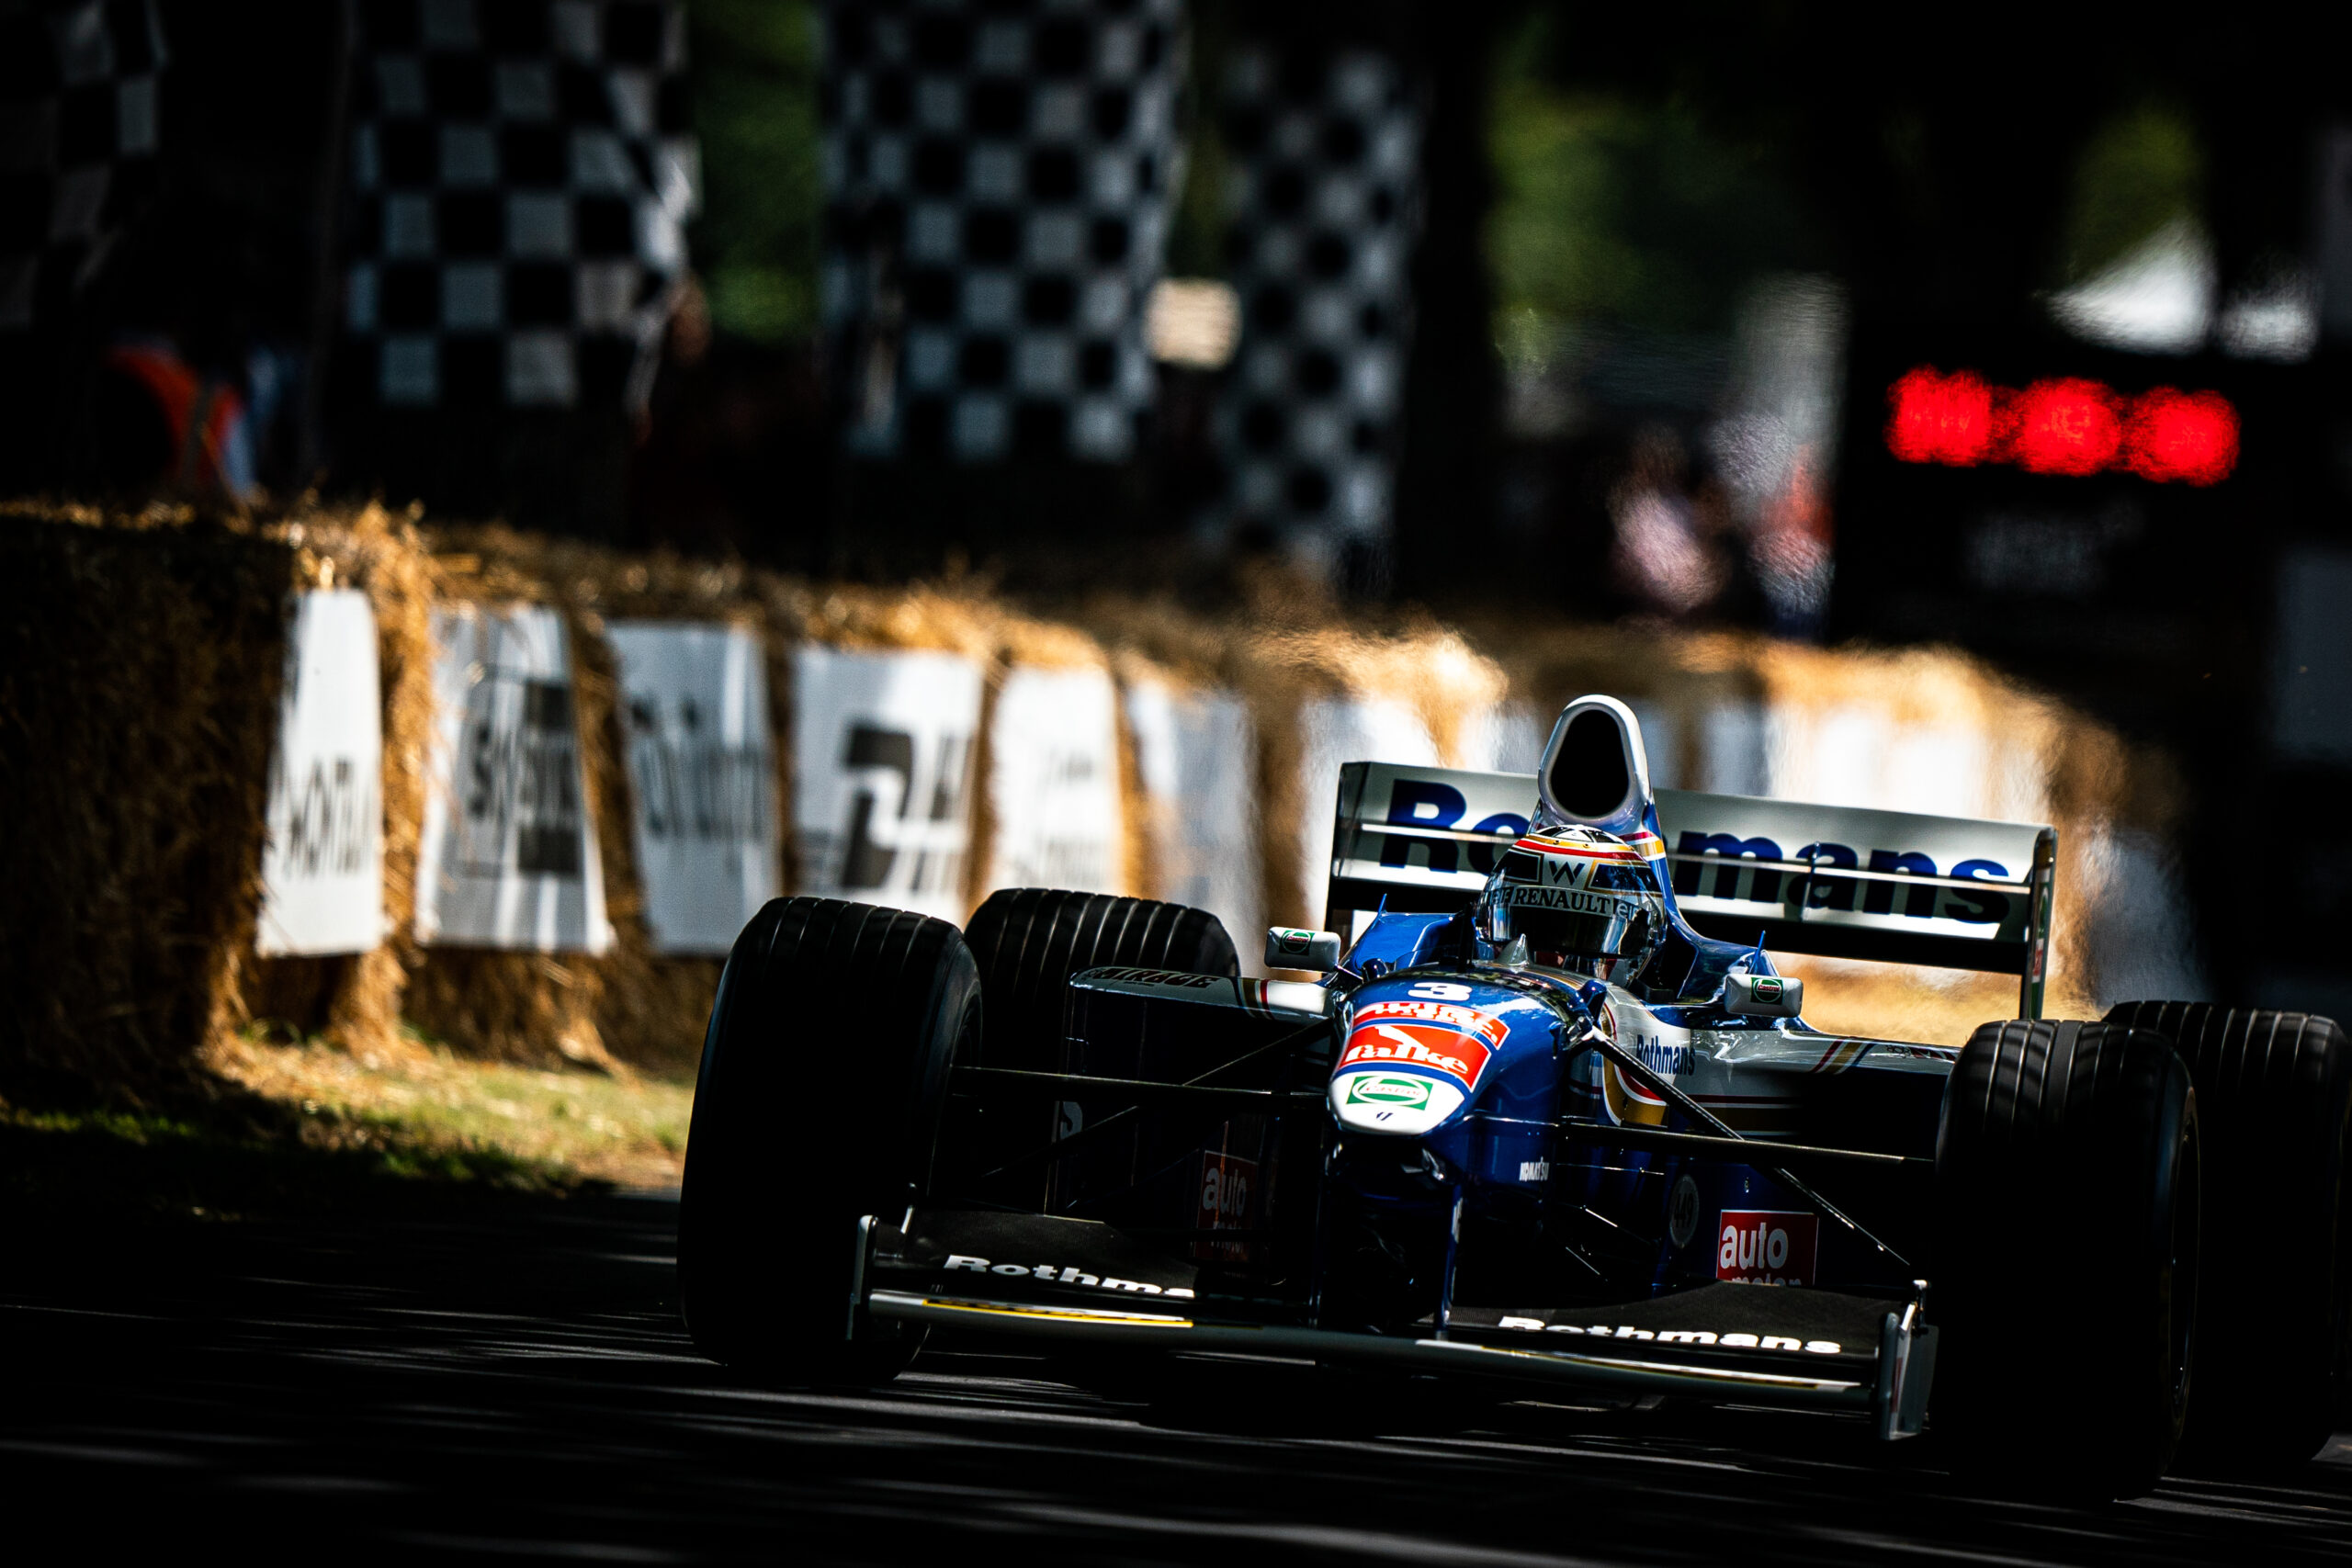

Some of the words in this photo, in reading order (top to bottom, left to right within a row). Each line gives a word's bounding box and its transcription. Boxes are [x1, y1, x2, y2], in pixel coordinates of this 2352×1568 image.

[1380, 779, 2010, 924] Romans
[1516, 888, 1611, 915] RENAULT
[1408, 981, 1473, 1001] 3
[1635, 1033, 1696, 1077] Rothmans
[1719, 1222, 1790, 1270] auto
[944, 1255, 1194, 1298] Rothma
